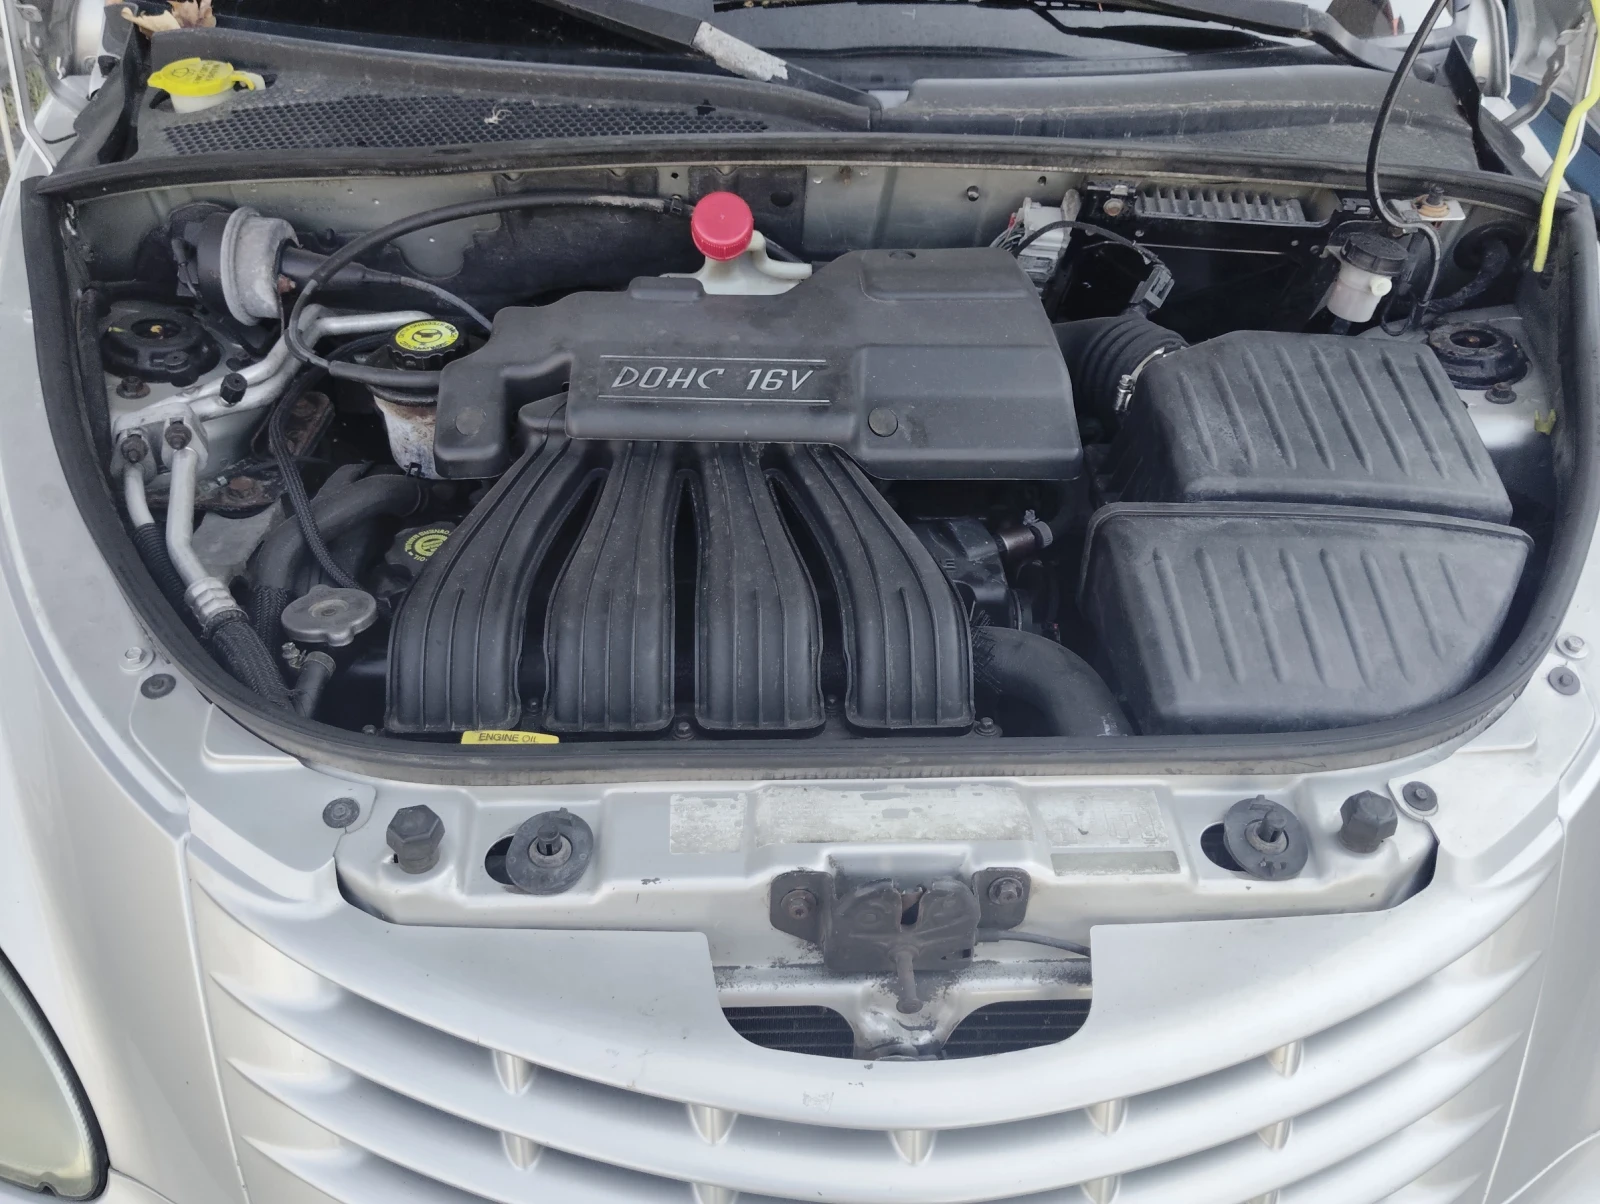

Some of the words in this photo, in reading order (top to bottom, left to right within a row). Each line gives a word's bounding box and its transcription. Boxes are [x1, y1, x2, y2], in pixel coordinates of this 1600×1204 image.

[611, 366, 726, 389] DOHC
[746, 368, 814, 391] 16V
[478, 732, 520, 743] ENGINE
[521, 734, 538, 743] OIL
